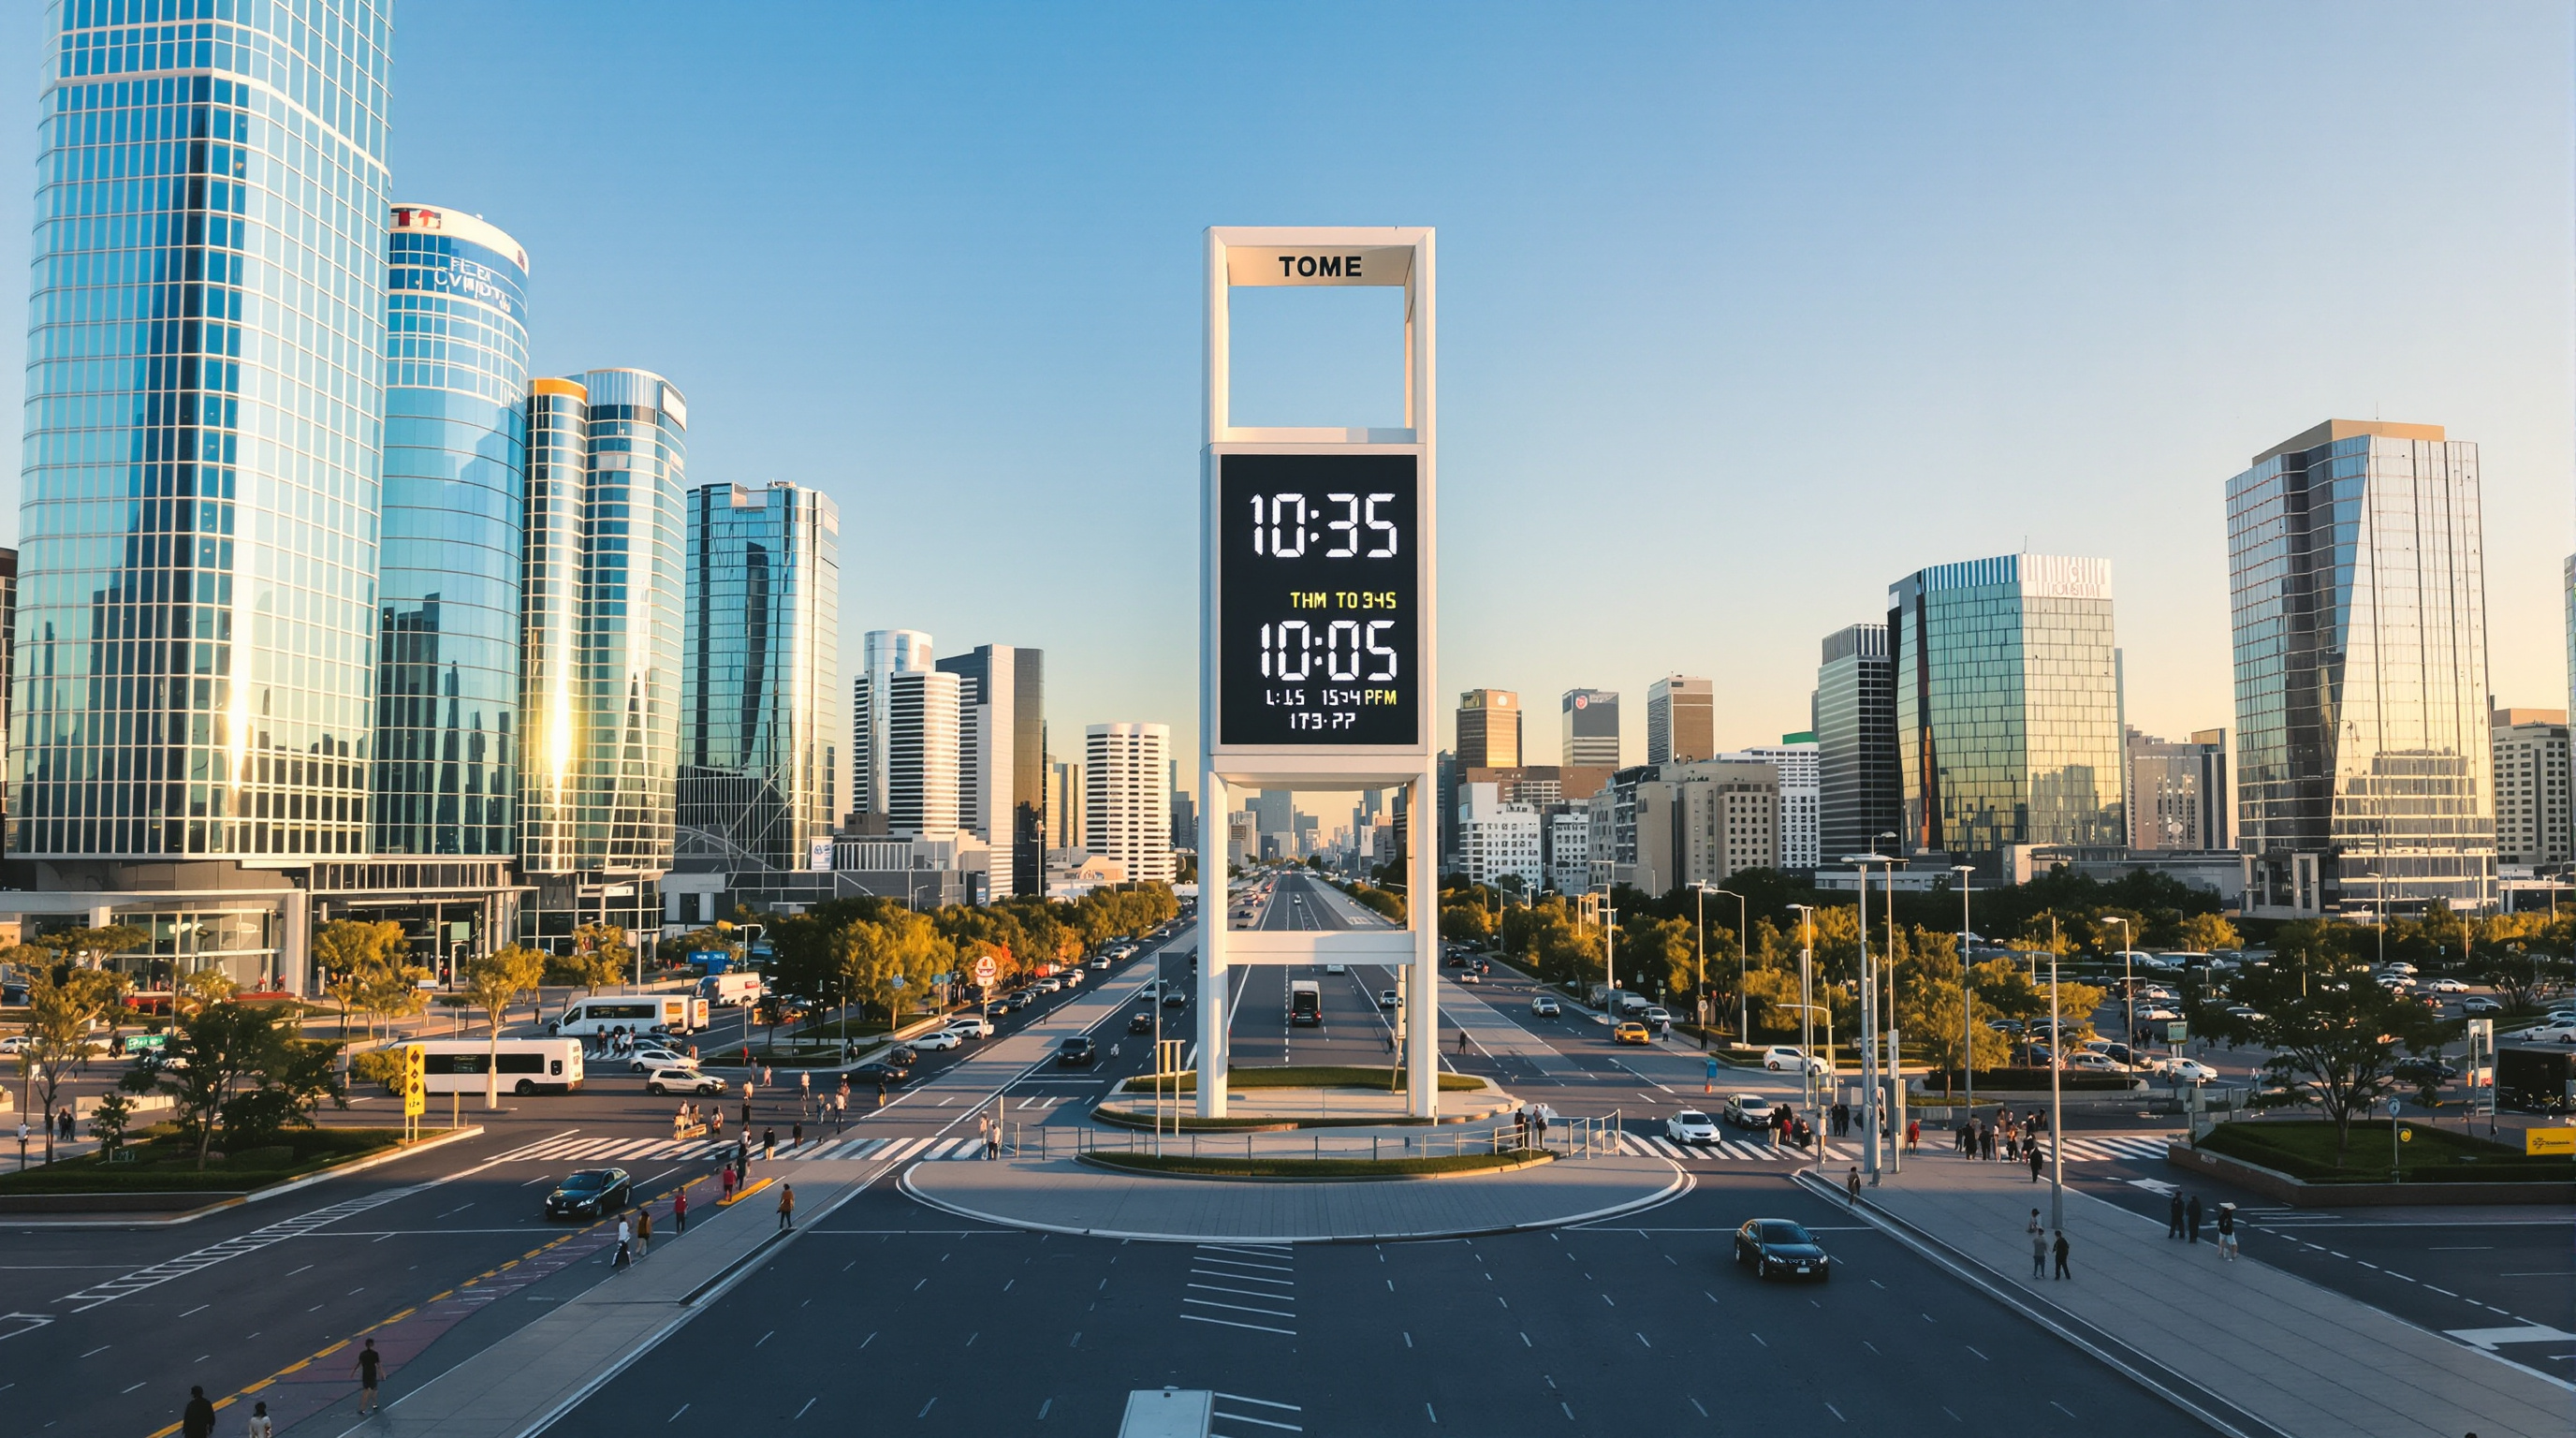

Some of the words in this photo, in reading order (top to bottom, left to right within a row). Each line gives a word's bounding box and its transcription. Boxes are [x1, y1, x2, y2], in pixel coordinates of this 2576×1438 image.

[1279, 256, 1362, 277] TOME
[1250, 492, 1398, 559] 10:35
[1290, 592, 1327, 609] THM
[1335, 592, 1358, 609] TO
[1261, 620, 1398, 682] 10:05
[1365, 689, 1398, 706] PFM
